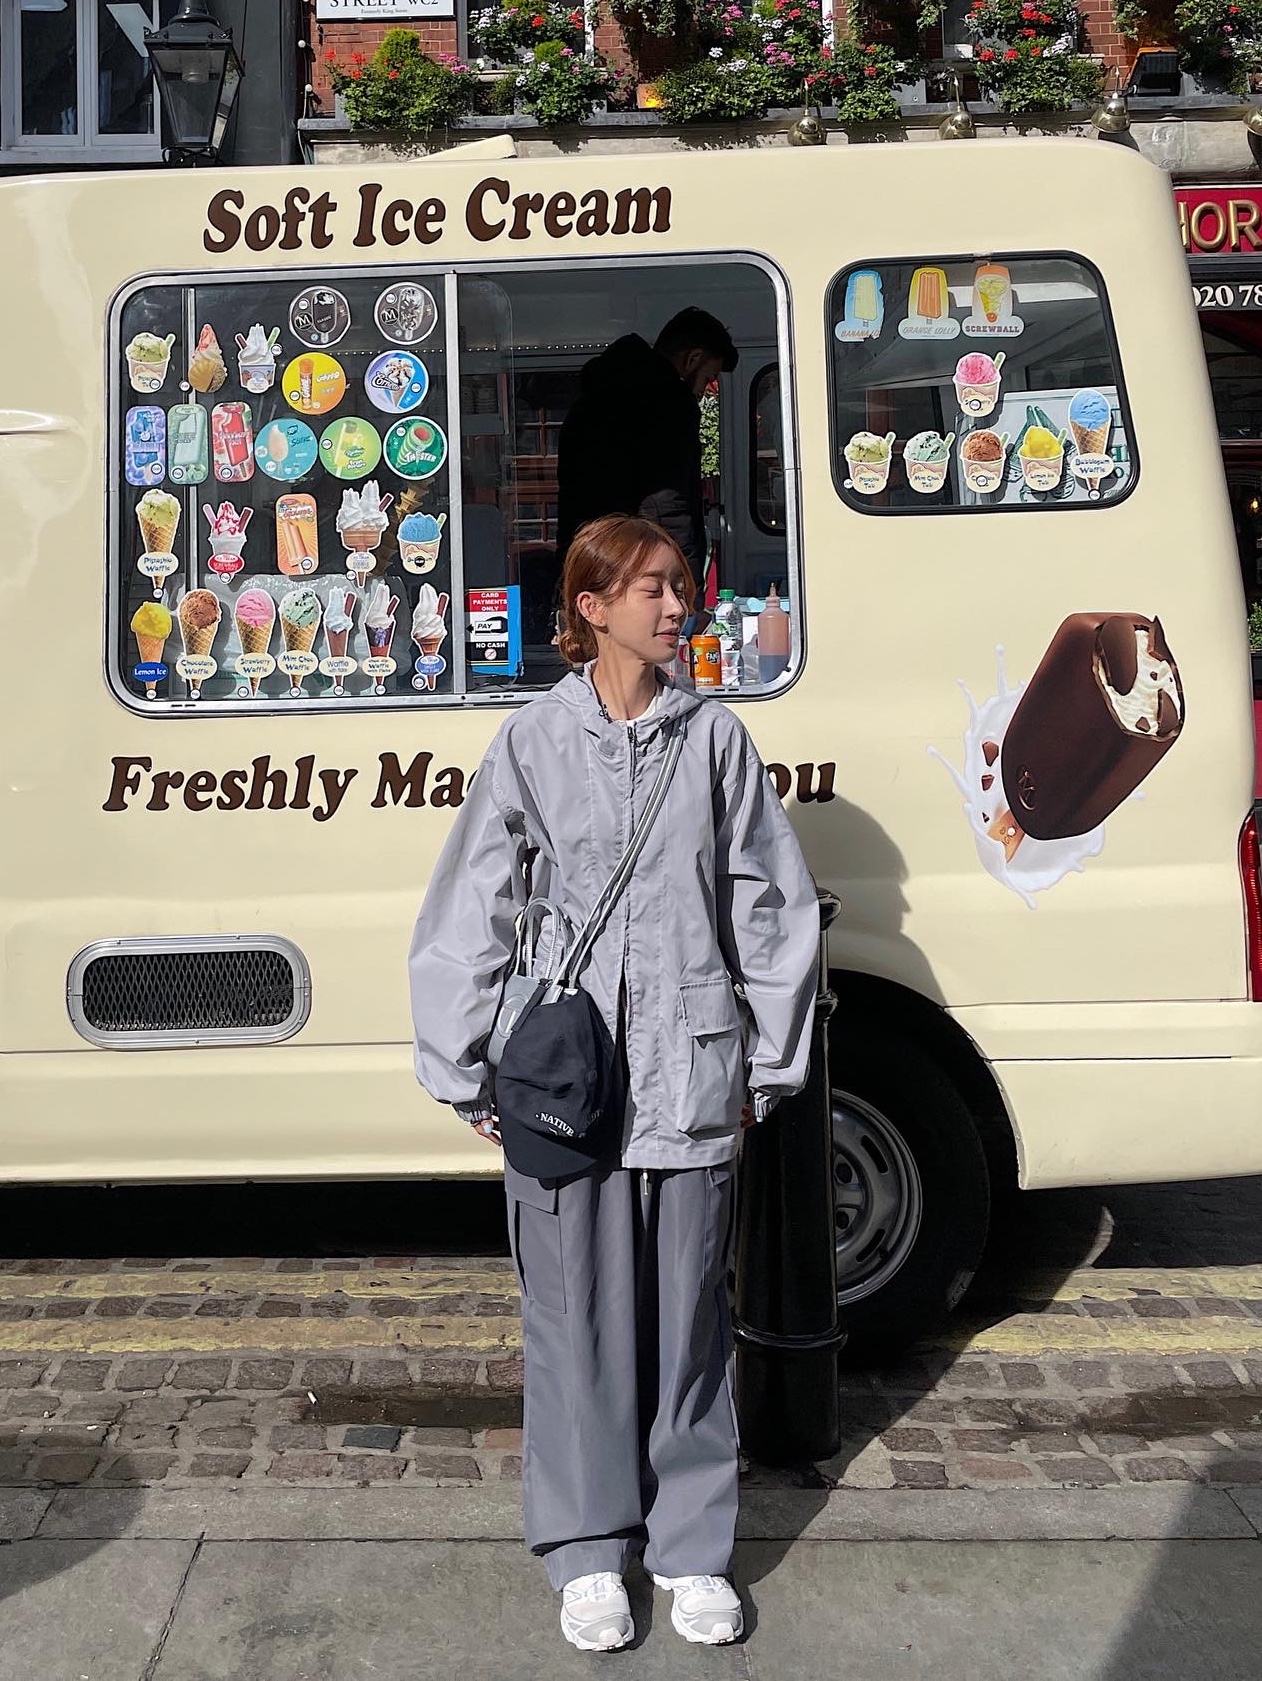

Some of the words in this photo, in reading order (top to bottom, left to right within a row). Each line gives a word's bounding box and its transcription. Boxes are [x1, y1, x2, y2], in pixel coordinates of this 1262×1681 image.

[203, 187, 338, 253] Soft
[352, 183, 447, 247] Ice
[465, 176, 672, 242] Cream
[902, 326, 932, 335] ORANGE
[934, 326, 957, 335] LOLLY
[965, 325, 1020, 333] SCREWBALL
[240, 658, 271, 666] Strawberry
[156, 667, 167, 675] Ice
[102, 755, 358, 822] Freshly
[540, 1112, 575, 1137] NATIVE
